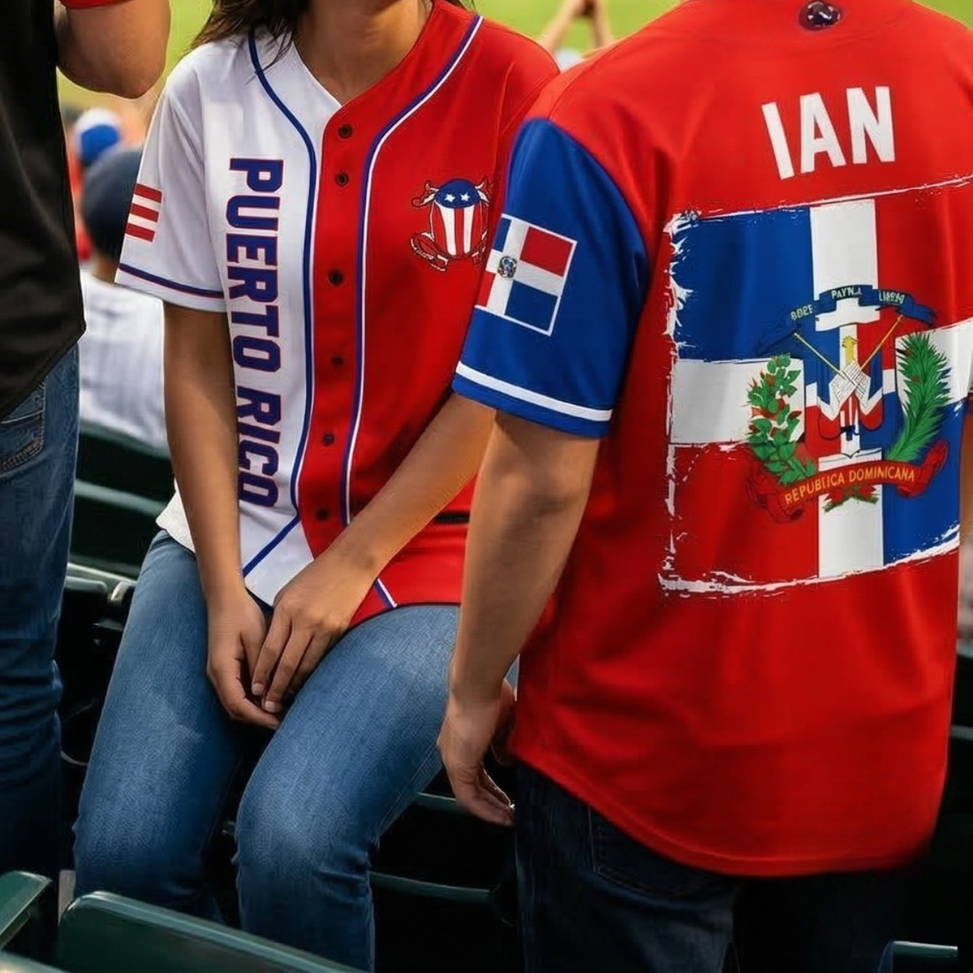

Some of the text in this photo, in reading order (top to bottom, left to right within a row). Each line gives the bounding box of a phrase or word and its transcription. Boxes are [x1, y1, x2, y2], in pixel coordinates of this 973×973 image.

[761, 85, 896, 180] IAN
[225, 158, 284, 508] PUERTO RICO
[784, 465, 916, 505] REPUBLICA DOMINICANA
